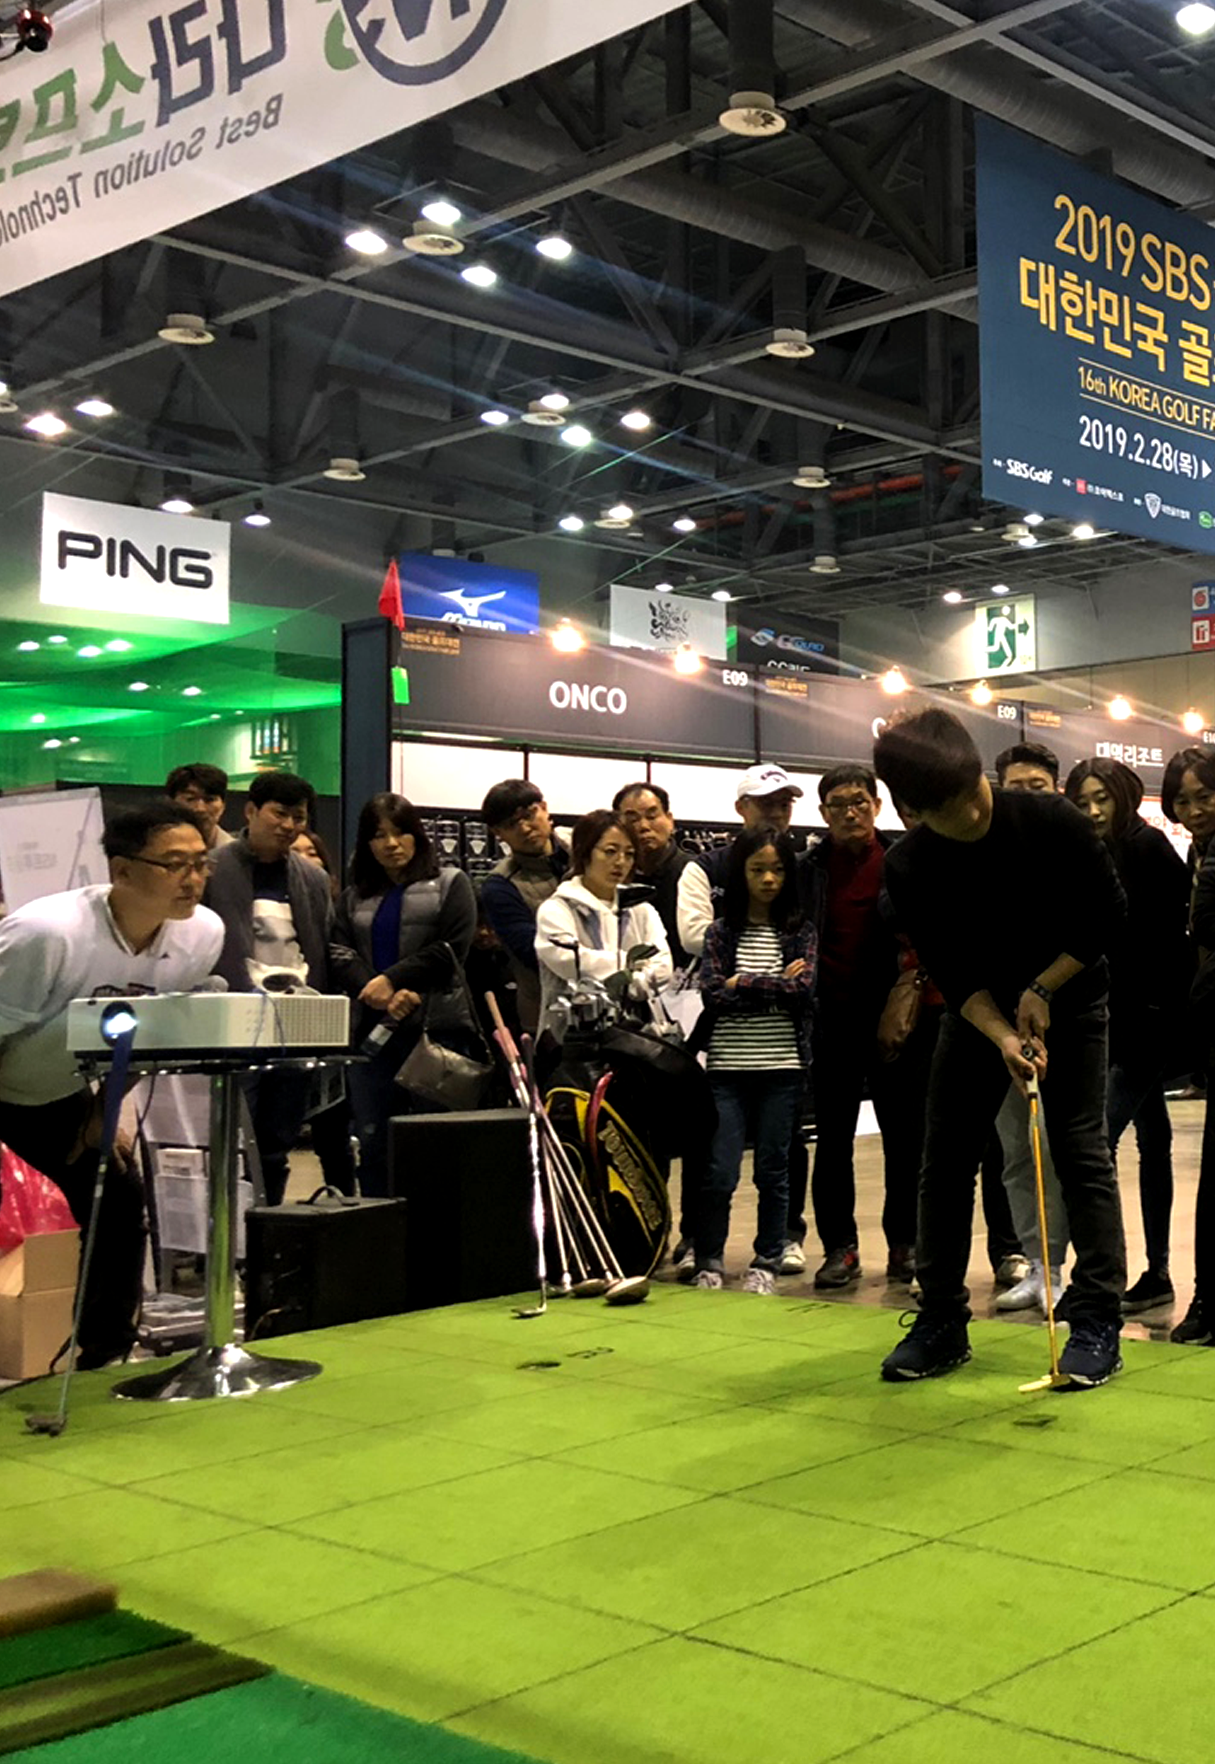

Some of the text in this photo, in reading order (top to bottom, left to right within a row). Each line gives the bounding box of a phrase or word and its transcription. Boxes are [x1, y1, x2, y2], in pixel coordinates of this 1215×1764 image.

[1019, 256, 1169, 372] 대한민국
[1078, 366, 1107, 396] 16th
[1109, 376, 1162, 415] KOREA
[1162, 396, 1200, 426] GOLF
[1079, 415, 1199, 480] 2019.2.28(목)
[58, 530, 213, 589] PING
[549, 681, 627, 714] ONCO
[722, 669, 749, 687] E09
[997, 705, 1018, 720] E09
